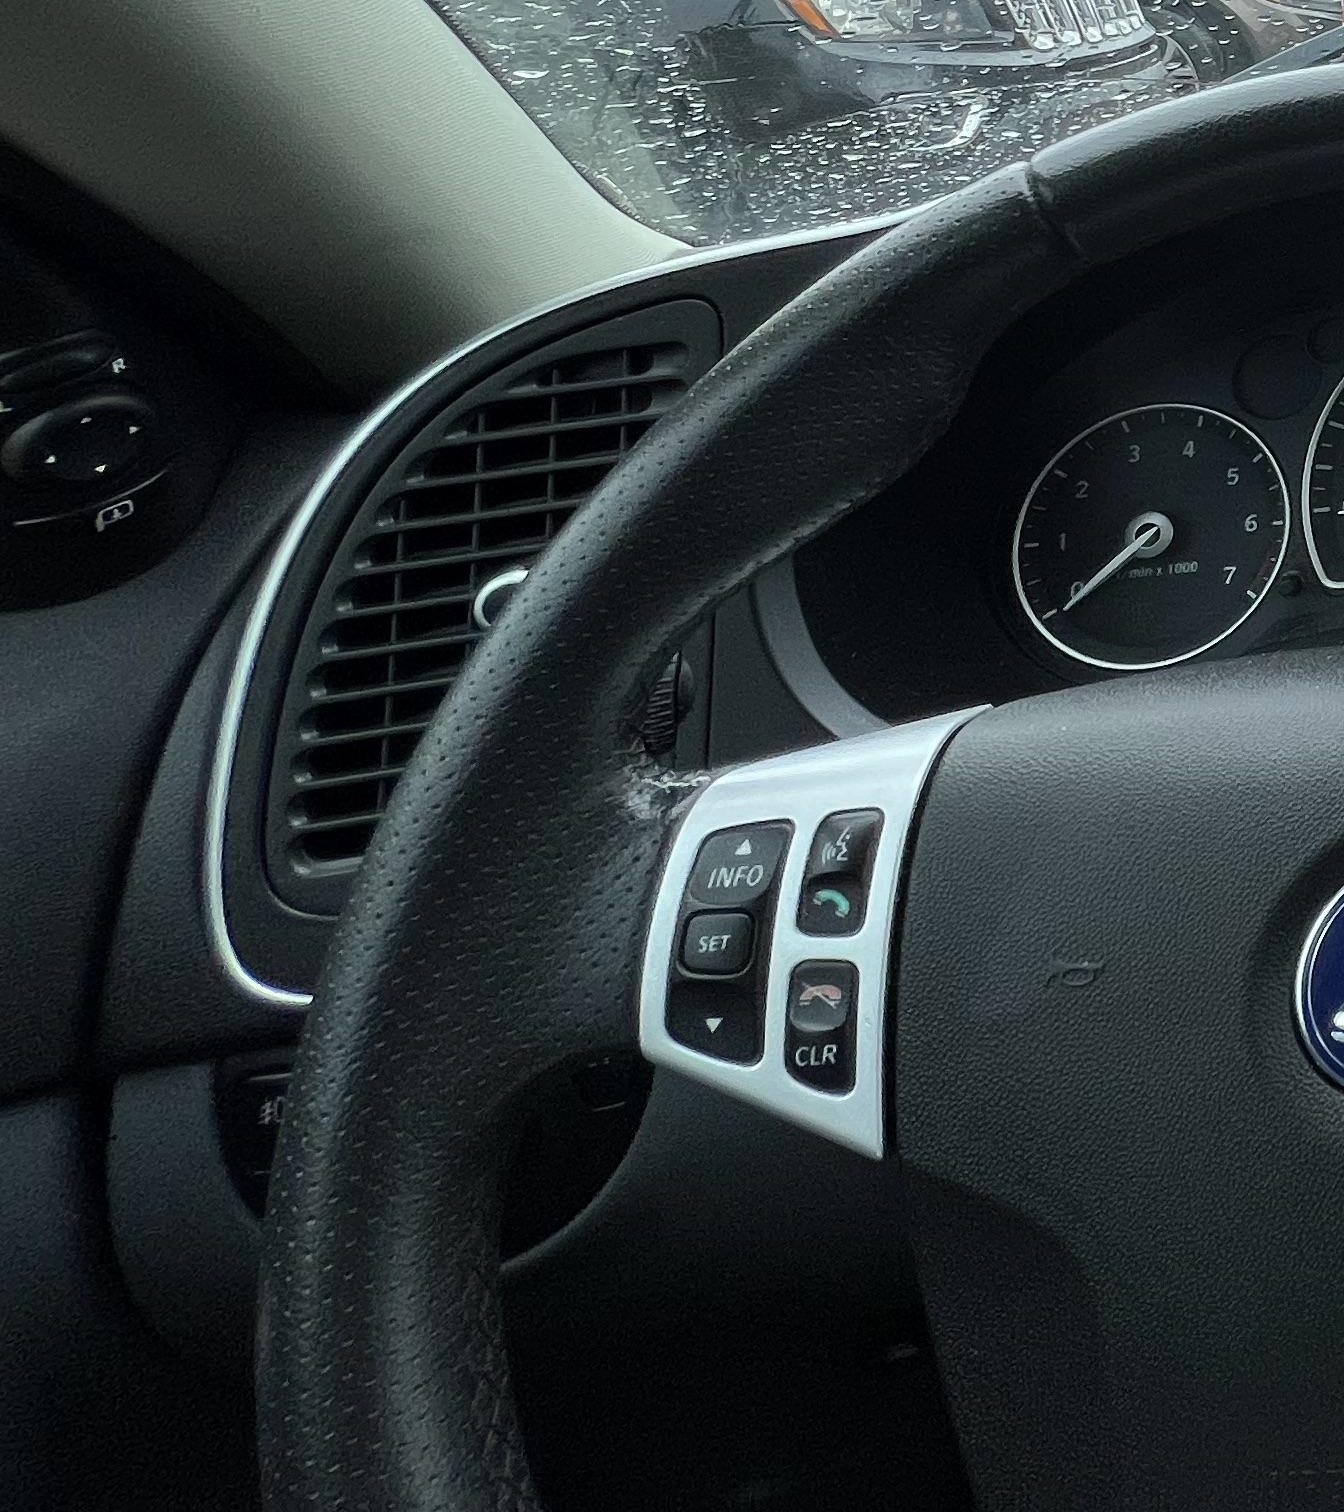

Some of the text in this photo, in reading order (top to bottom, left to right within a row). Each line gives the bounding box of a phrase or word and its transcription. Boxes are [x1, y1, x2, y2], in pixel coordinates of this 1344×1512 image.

[1127, 445, 1141, 463] 3
[1182, 440, 1196, 458] 4
[1227, 468, 1240, 486] 5
[1075, 480, 1090, 499] 2
[1244, 514, 1258, 532] 6
[1059, 533, 1067, 551] 1
[1168, 560, 1200, 575] 1000
[1223, 566, 1237, 585] 7
[707, 864, 764, 889] INFO
[698, 934, 731, 953] SET
[795, 1044, 839, 1068] CLR
